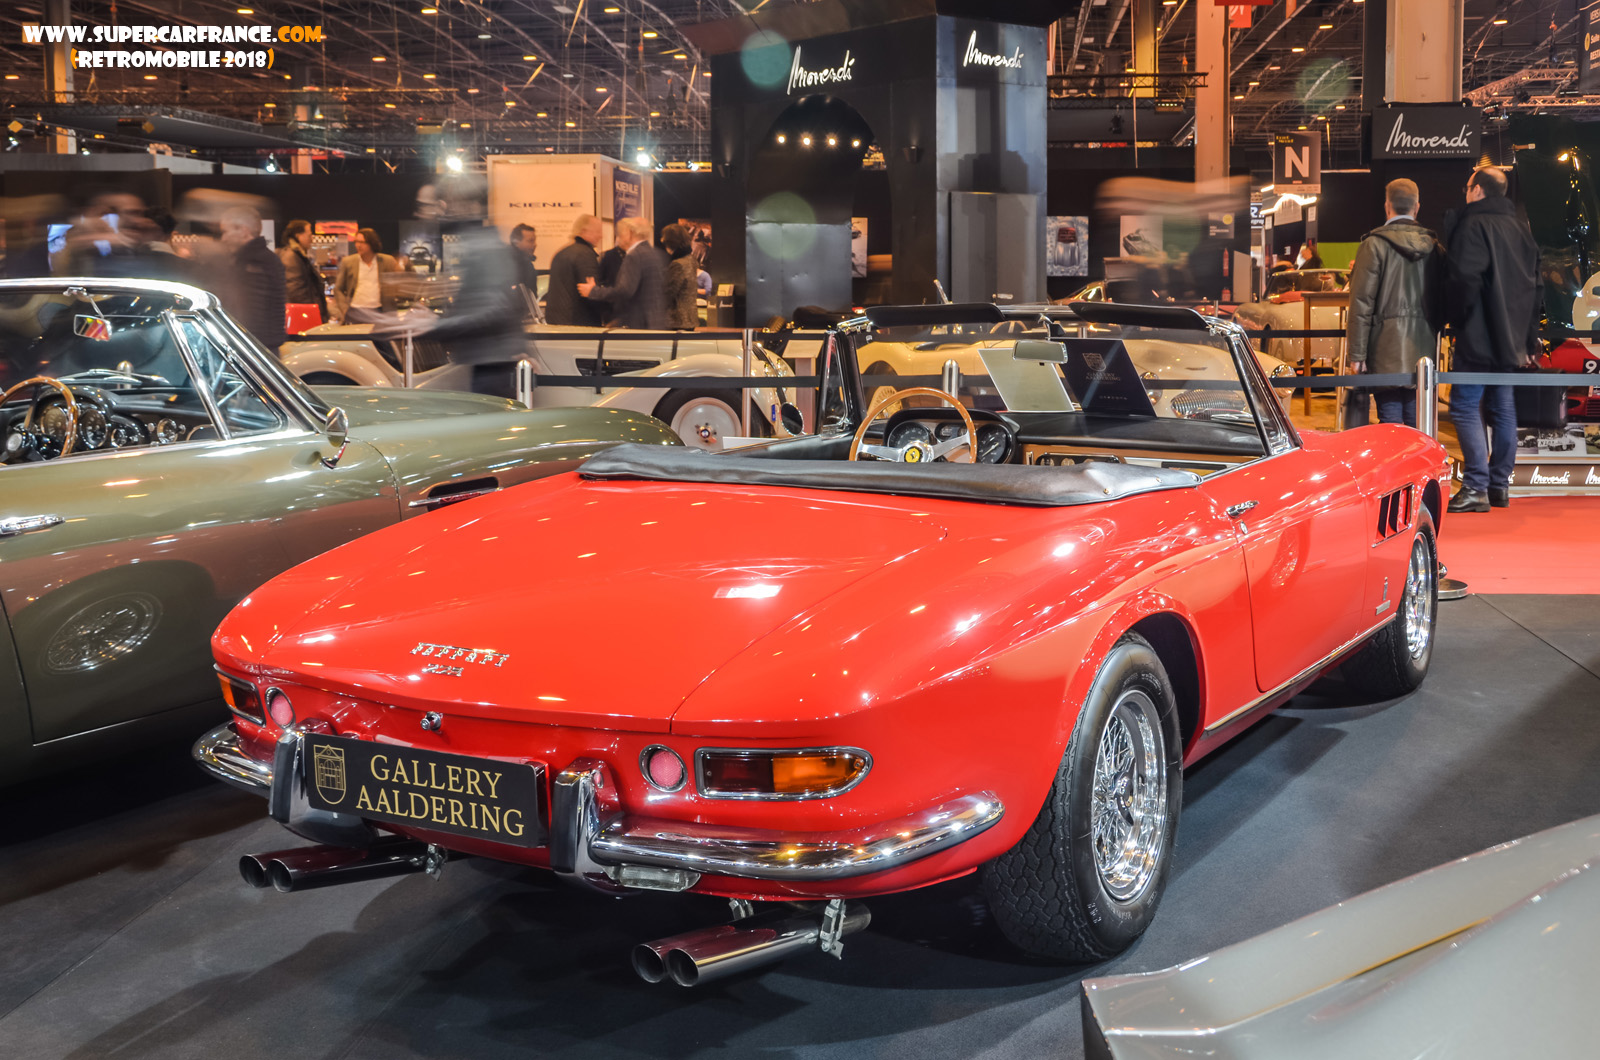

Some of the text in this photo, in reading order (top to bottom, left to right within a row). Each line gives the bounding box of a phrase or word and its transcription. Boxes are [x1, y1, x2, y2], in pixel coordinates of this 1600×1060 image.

[963, 30, 1024, 68] Movendi
[786, 44, 855, 95] Movendi
[1385, 112, 1473, 152] Movendi
[1285, 146, 1309, 178] N
[509, 201, 583, 209] KIENLE
[410, 642, 509, 667] Ferrari
[370, 754, 502, 799] GALLERY
[355, 784, 525, 836] AALDERING
